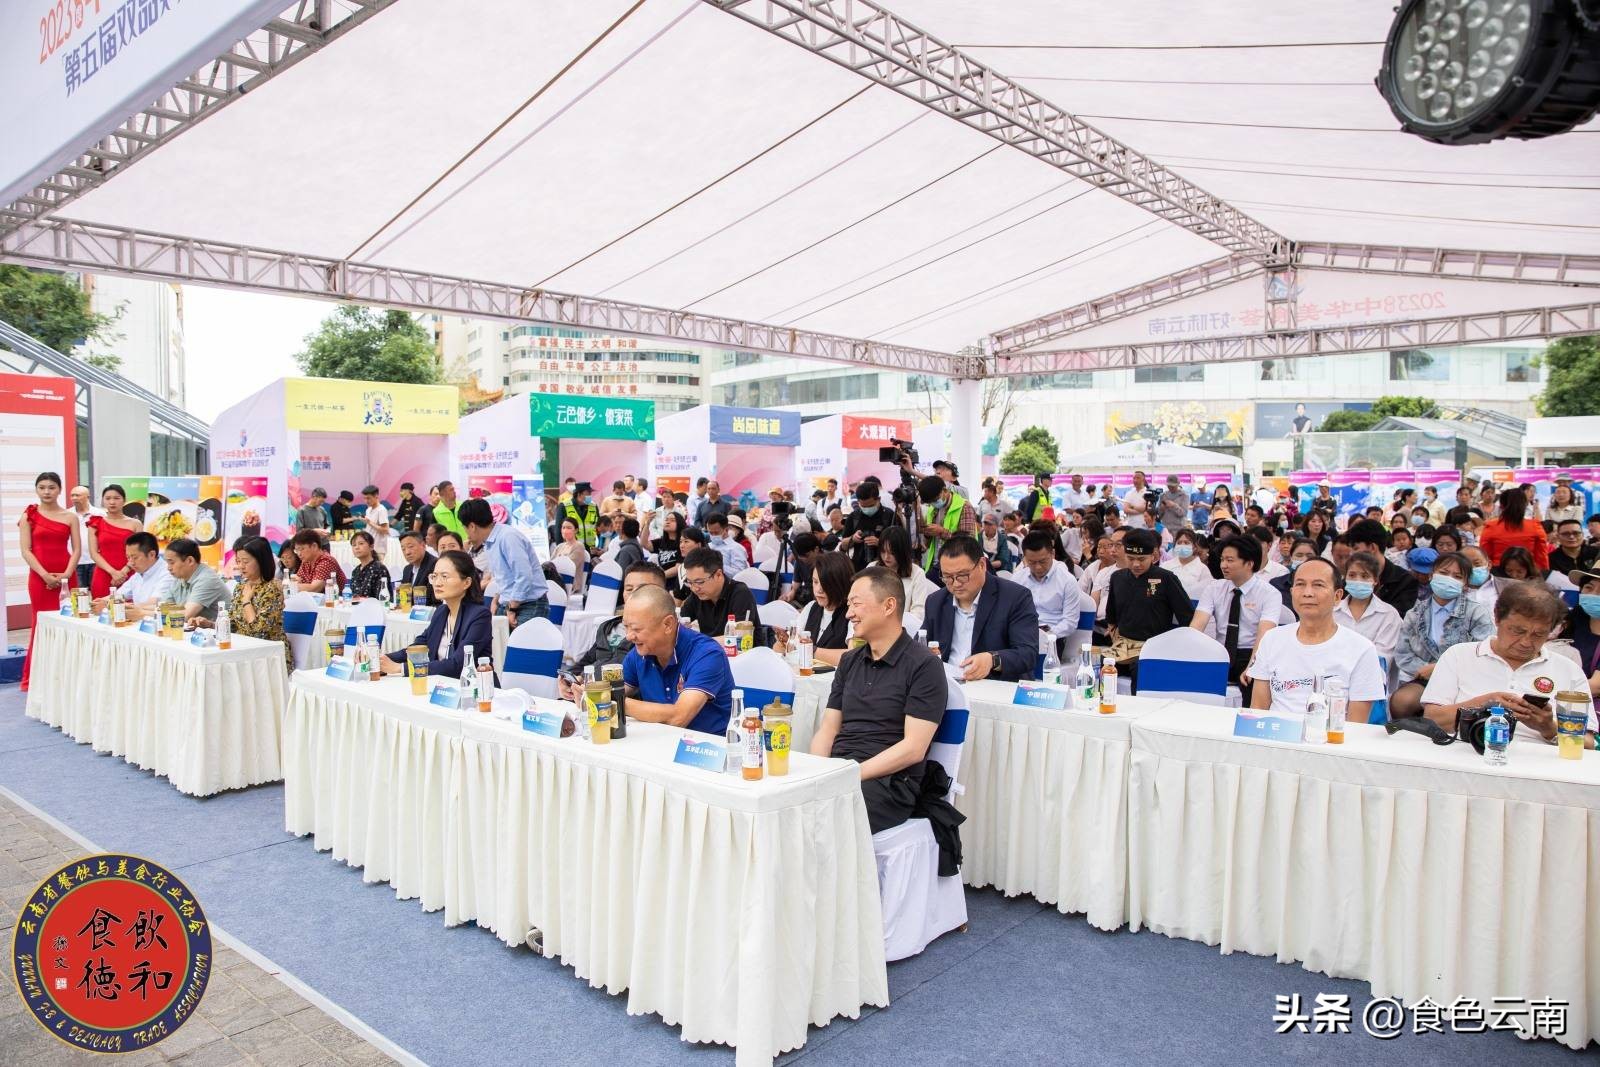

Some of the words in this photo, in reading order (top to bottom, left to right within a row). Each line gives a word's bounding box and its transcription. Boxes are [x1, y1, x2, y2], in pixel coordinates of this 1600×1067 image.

[565, 338, 585, 349] 民主
[591, 339, 611, 349] 文明
[617, 339, 638, 349] 和谐
[539, 361, 559, 371] 自由
[565, 362, 585, 372] 平等
[591, 362, 611, 371] 公正
[617, 362, 638, 371] 法治
[539, 383, 559, 392] 爱国
[591, 385, 611, 394] 诚信
[733, 416, 781, 435] 尚品味道
